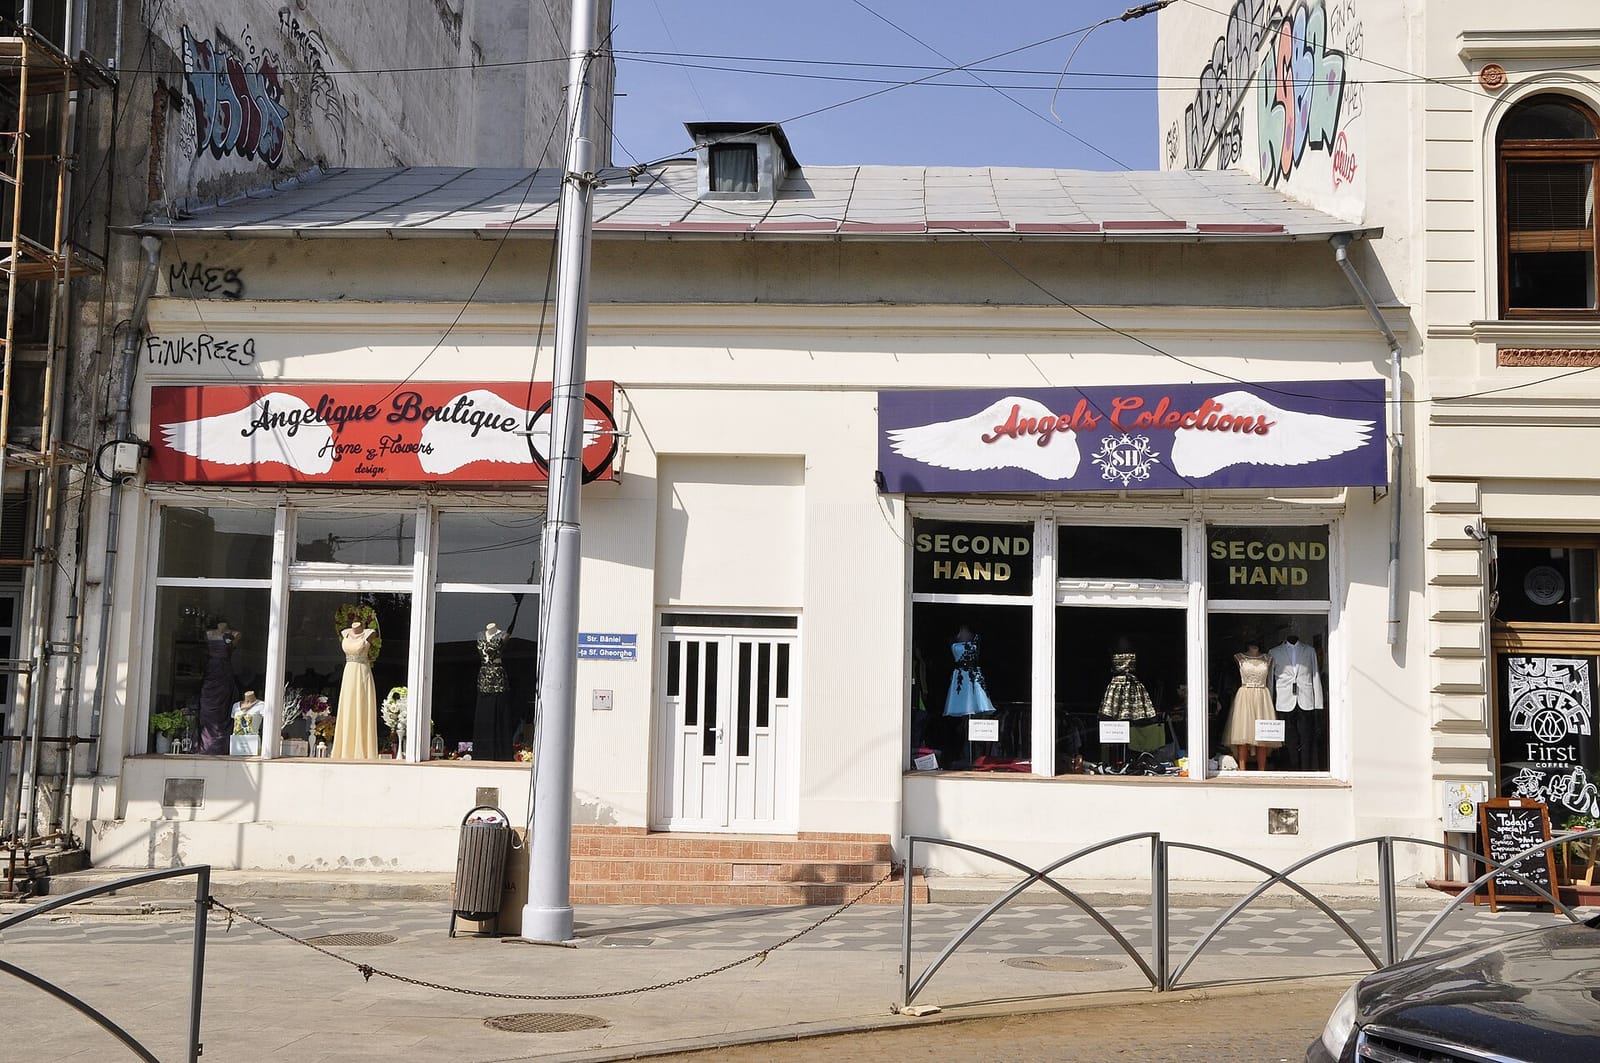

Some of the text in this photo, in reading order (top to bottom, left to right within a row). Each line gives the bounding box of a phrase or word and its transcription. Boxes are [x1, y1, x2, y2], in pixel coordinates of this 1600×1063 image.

[169, 262, 244, 299] MAES
[241, 391, 520, 437] Angelique Boutique
[981, 396, 1276, 447] Angels Colections
[318, 434, 434, 461] Home & Flowers
[355, 463, 385, 477] design
[915, 533, 1030, 556] SECOND
[1210, 540, 1326, 561] SECOND
[933, 560, 1012, 581] HAND
[1229, 566, 1309, 585] HAND
[586, 635, 599, 643] Str.
[600, 649, 632, 658] Gheorghe
[1526, 742, 1577, 761] First
[1496, 813, 1534, 832] Today's
